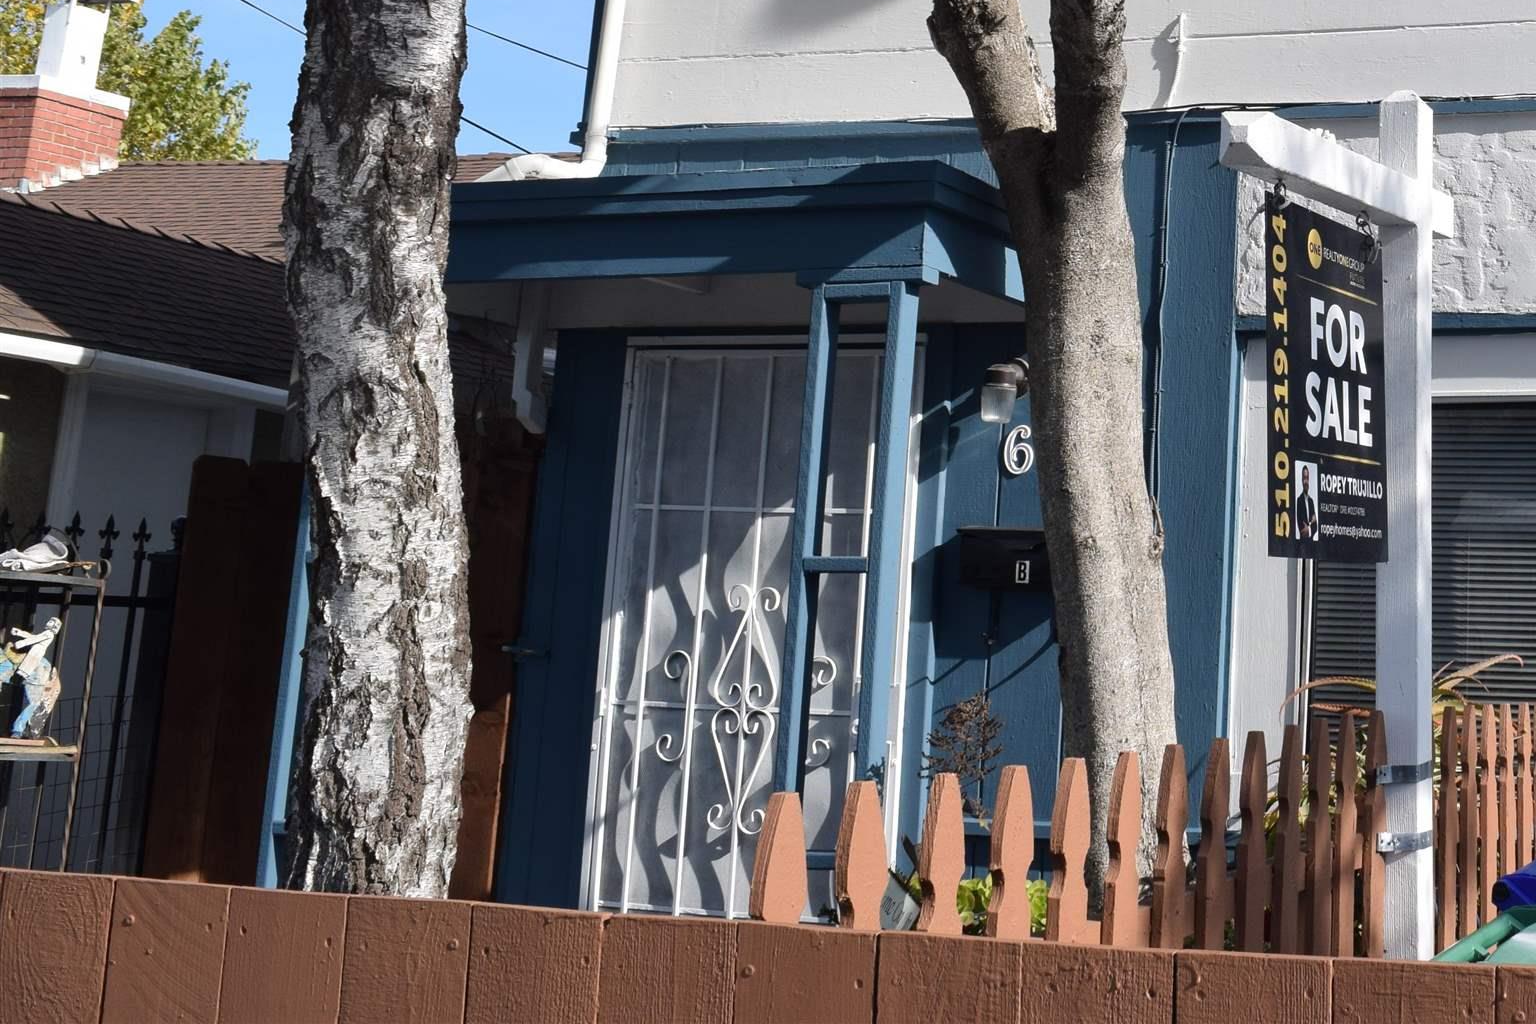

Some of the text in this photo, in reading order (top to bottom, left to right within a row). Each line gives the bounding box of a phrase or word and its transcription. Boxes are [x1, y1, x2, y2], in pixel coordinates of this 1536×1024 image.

[1309, 242, 1321, 257] ONE
[1310, 296, 1368, 375] FOR
[1272, 214, 1291, 539] 510.219.1404
[1305, 371, 1373, 448] SALE
[1003, 425, 1034, 474] 6
[1320, 473, 1383, 500] ROPEY TRUJILLO
[1320, 523, 1382, 540] ropeyhomes@yahoo.com
[1017, 561, 1028, 582] B
